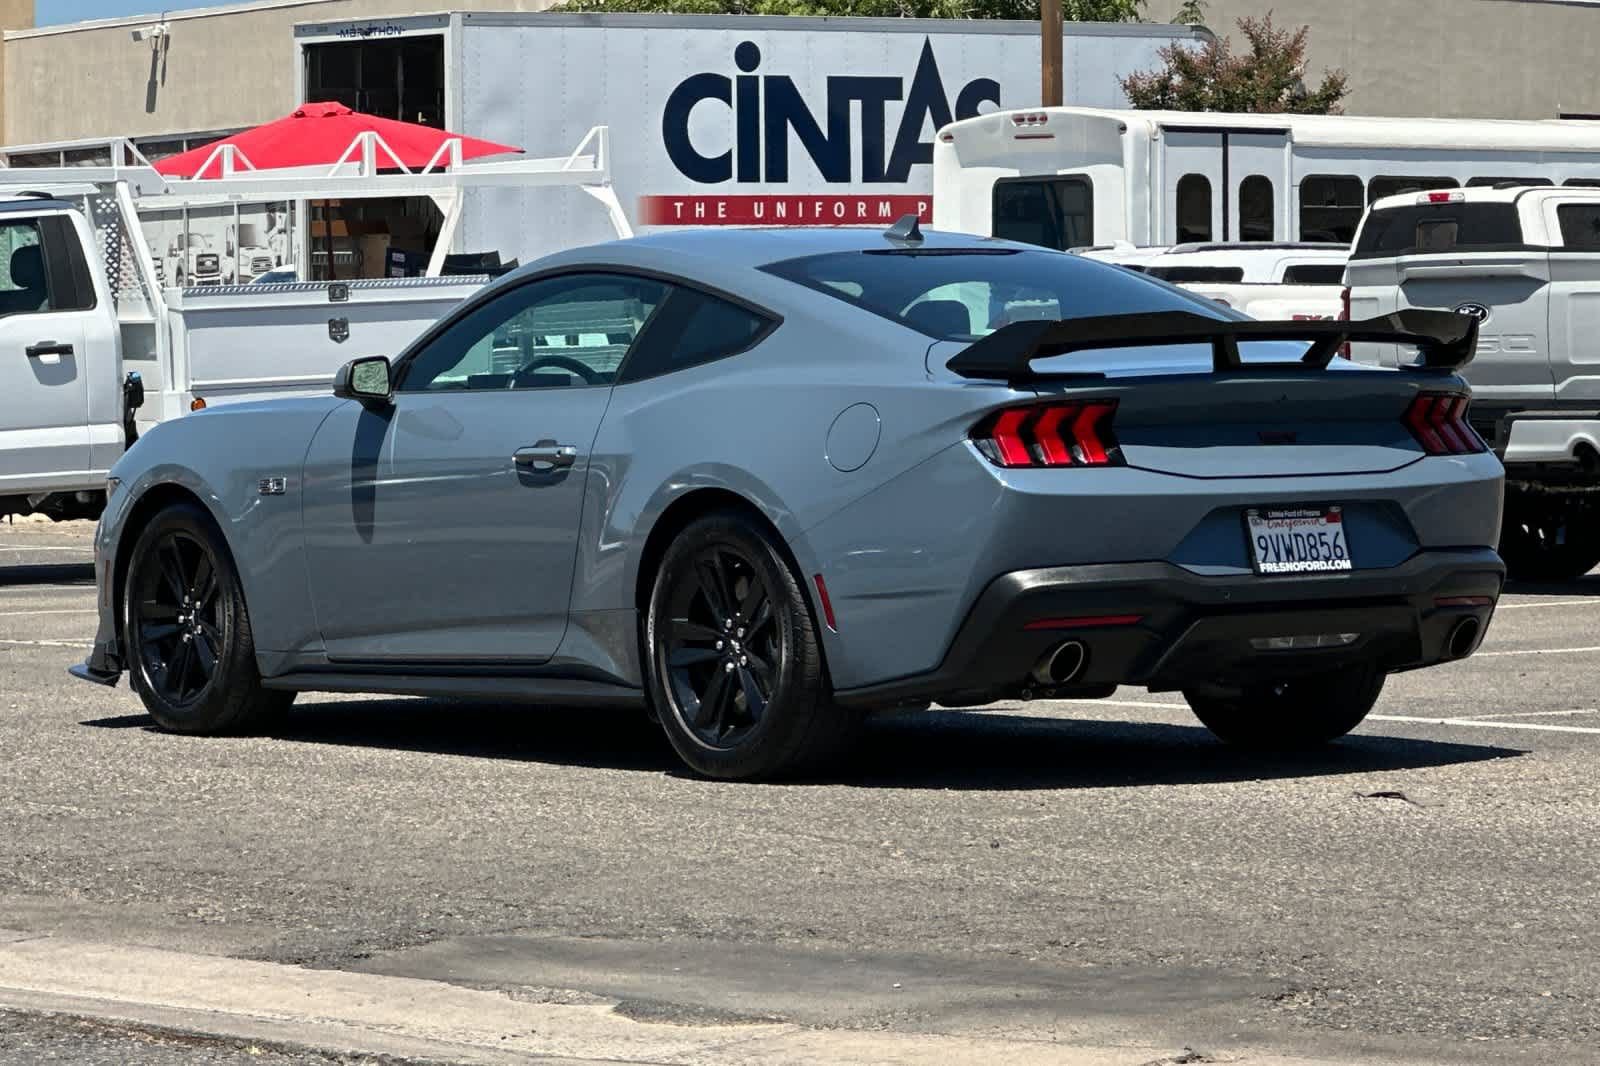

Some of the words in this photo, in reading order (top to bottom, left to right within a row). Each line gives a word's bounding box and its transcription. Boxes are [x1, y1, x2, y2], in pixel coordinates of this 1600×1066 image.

[674, 202, 727, 218] THE
[753, 202, 891, 218] UNIFORM
[1266, 518, 1327, 531] California
[1257, 531, 1344, 562] 9VWD856
[1259, 559, 1352, 573] FRESNOFORD.COM
